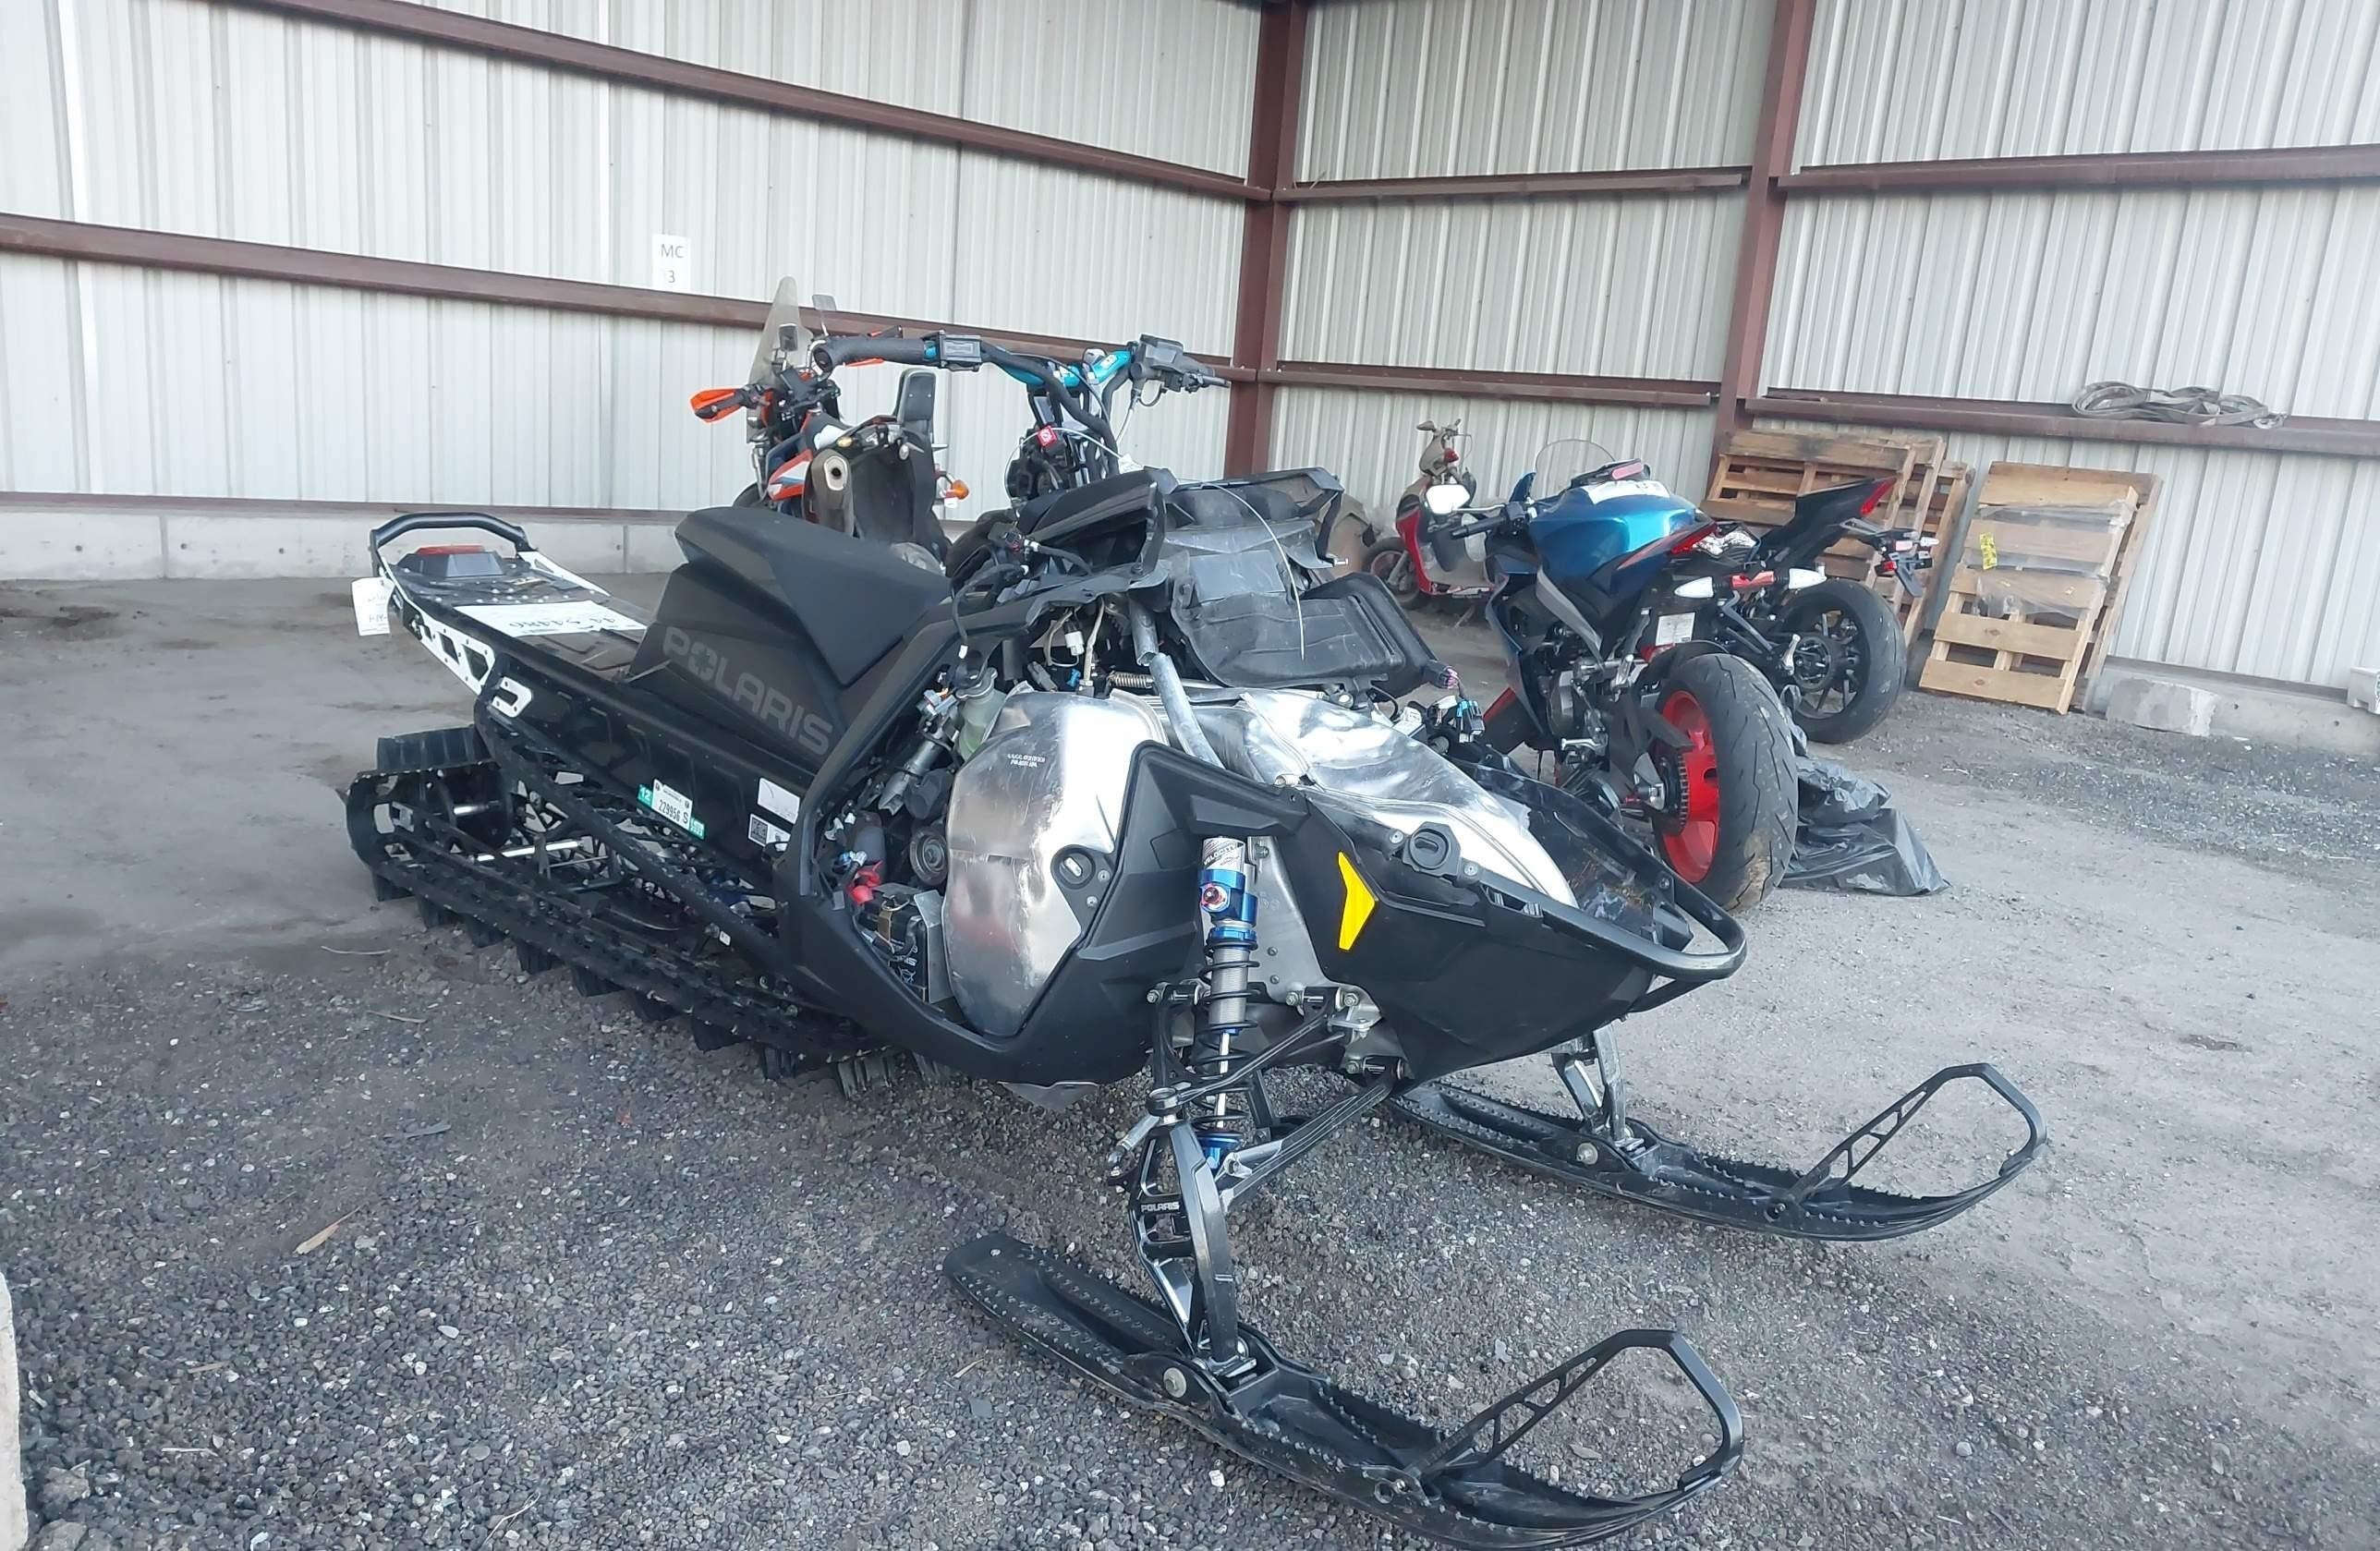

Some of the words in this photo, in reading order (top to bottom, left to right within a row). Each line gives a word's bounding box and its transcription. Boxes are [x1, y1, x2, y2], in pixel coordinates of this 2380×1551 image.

[661, 243, 686, 259] MC
[667, 270, 676, 284] 3
[662, 625, 833, 757] POLARIS
[640, 787, 651, 801] 12
[682, 811, 689, 824] S
[1140, 1201, 1180, 1212] POLARIS
